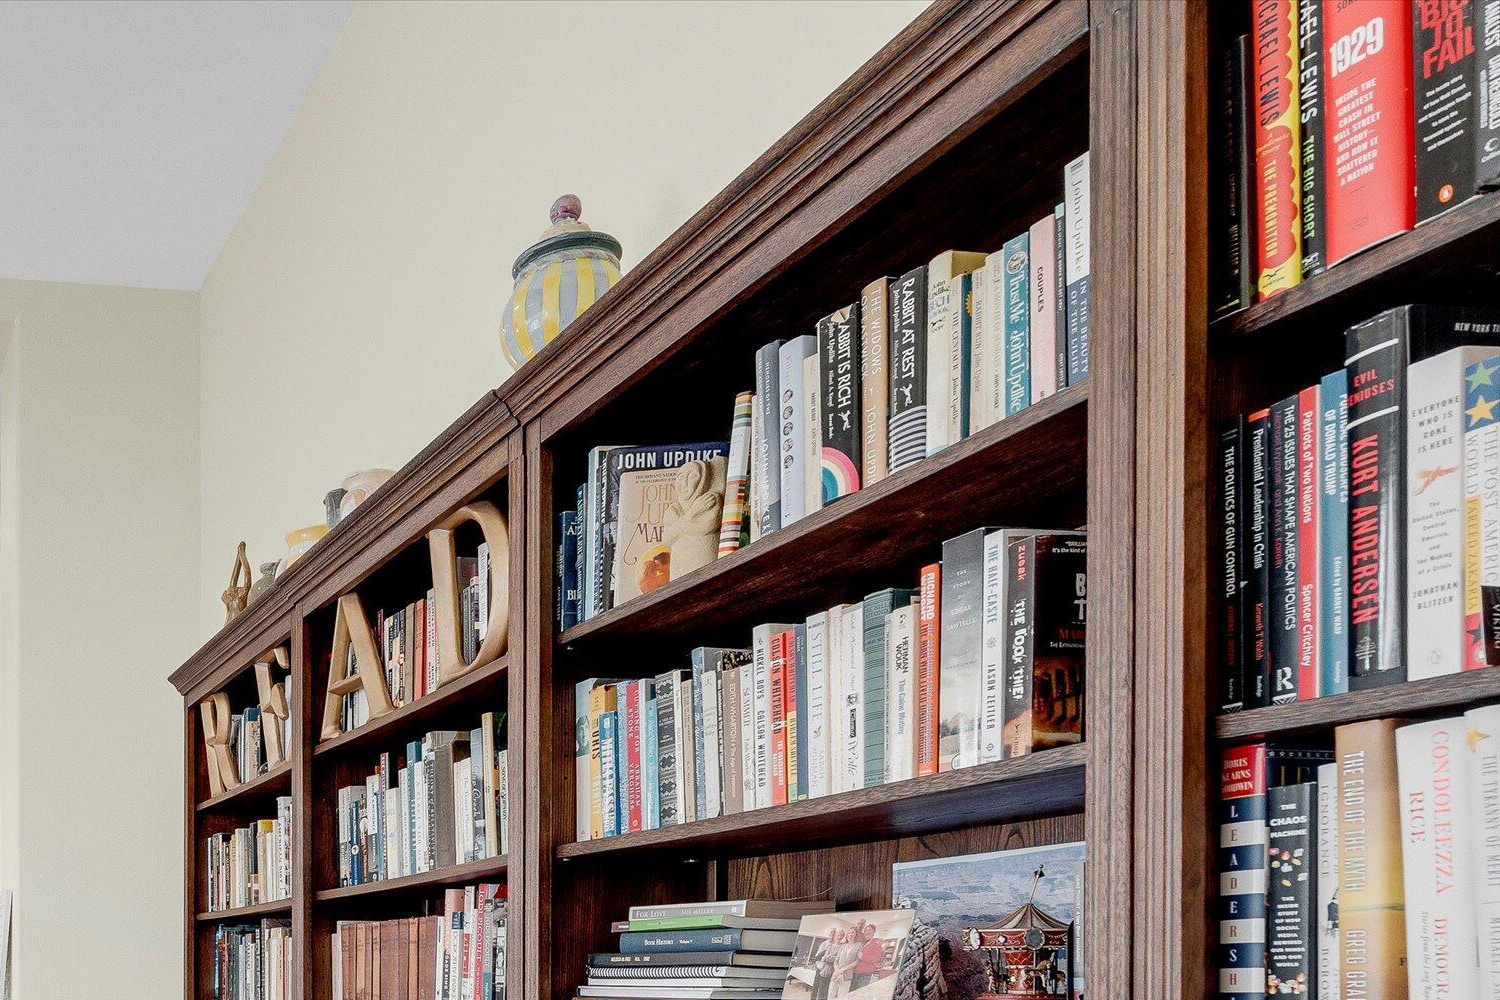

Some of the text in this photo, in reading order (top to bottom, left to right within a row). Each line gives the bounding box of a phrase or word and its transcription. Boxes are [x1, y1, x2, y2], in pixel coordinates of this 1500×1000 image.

[1330, 17, 1383, 78] 1929
[1423, 27, 1475, 79] FAIL
[1261, 66, 1279, 126] LEWIS
[1301, 52, 1317, 123] LEWIS
[1335, 78, 1376, 107] INSIDE THE
[1338, 91, 1374, 117] GREATEST
[1339, 108, 1362, 128] CRASH
[1353, 112, 1380, 132] STREET
[1337, 150, 1378, 176] SHATTERED
[1303, 135, 1315, 238] THE BIG SHORT
[1264, 160, 1277, 259] THE PREMONITION
[871, 288, 882, 375] THE WIDOWS
[902, 277, 915, 379] RABBIT REST
[838, 376, 851, 408] RICH
[1353, 370, 1378, 388] EVIL
[866, 405, 876, 438] JOHN
[1411, 395, 1460, 419] EVERYONE
[1422, 425, 1448, 441] GONE
[1429, 437, 1454, 451] HERE
[617, 452, 657, 469] JOHN
[1225, 446, 1234, 467] THE
[1225, 468, 1235, 511] POLITICS
[1252, 428, 1264, 569] Presidential Leadership Crisis
[1225, 527, 1235, 549] GUN
[1284, 441, 1296, 630] ISSUES THAT SHAPE AMERICAN POLITICS
[1351, 433, 1379, 626] KURT ANDERSEN
[1226, 551, 1235, 598] CONTROL
[1301, 485, 1314, 667] Nations Spencer Critchley
[1412, 581, 1459, 600] JONATHAN
[926, 573, 935, 620] RICHARD
[1417, 594, 1454, 611] BLITZER
[987, 570, 998, 730] HALF-CASTE JASON ZEITLER
[772, 638, 782, 735] COLSON WHITEHEAD
[812, 632, 822, 720] STILL LIFE
[757, 710, 765, 740] COLSON
[757, 744, 766, 788] WHITEHEAD
[1343, 751, 1364, 775] THE
[1280, 803, 1297, 811] THE
[1344, 779, 1365, 805] END
[1270, 815, 1308, 827] CHAOS
[1410, 792, 1426, 843] RICE
[1432, 731, 1454, 894] CONDOLEEZZA
[1270, 829, 1307, 839] MACHINE
[1345, 855, 1366, 892] MYTH
[476, 918, 484, 962] PICOULT
[1346, 930, 1366, 965] GREG
